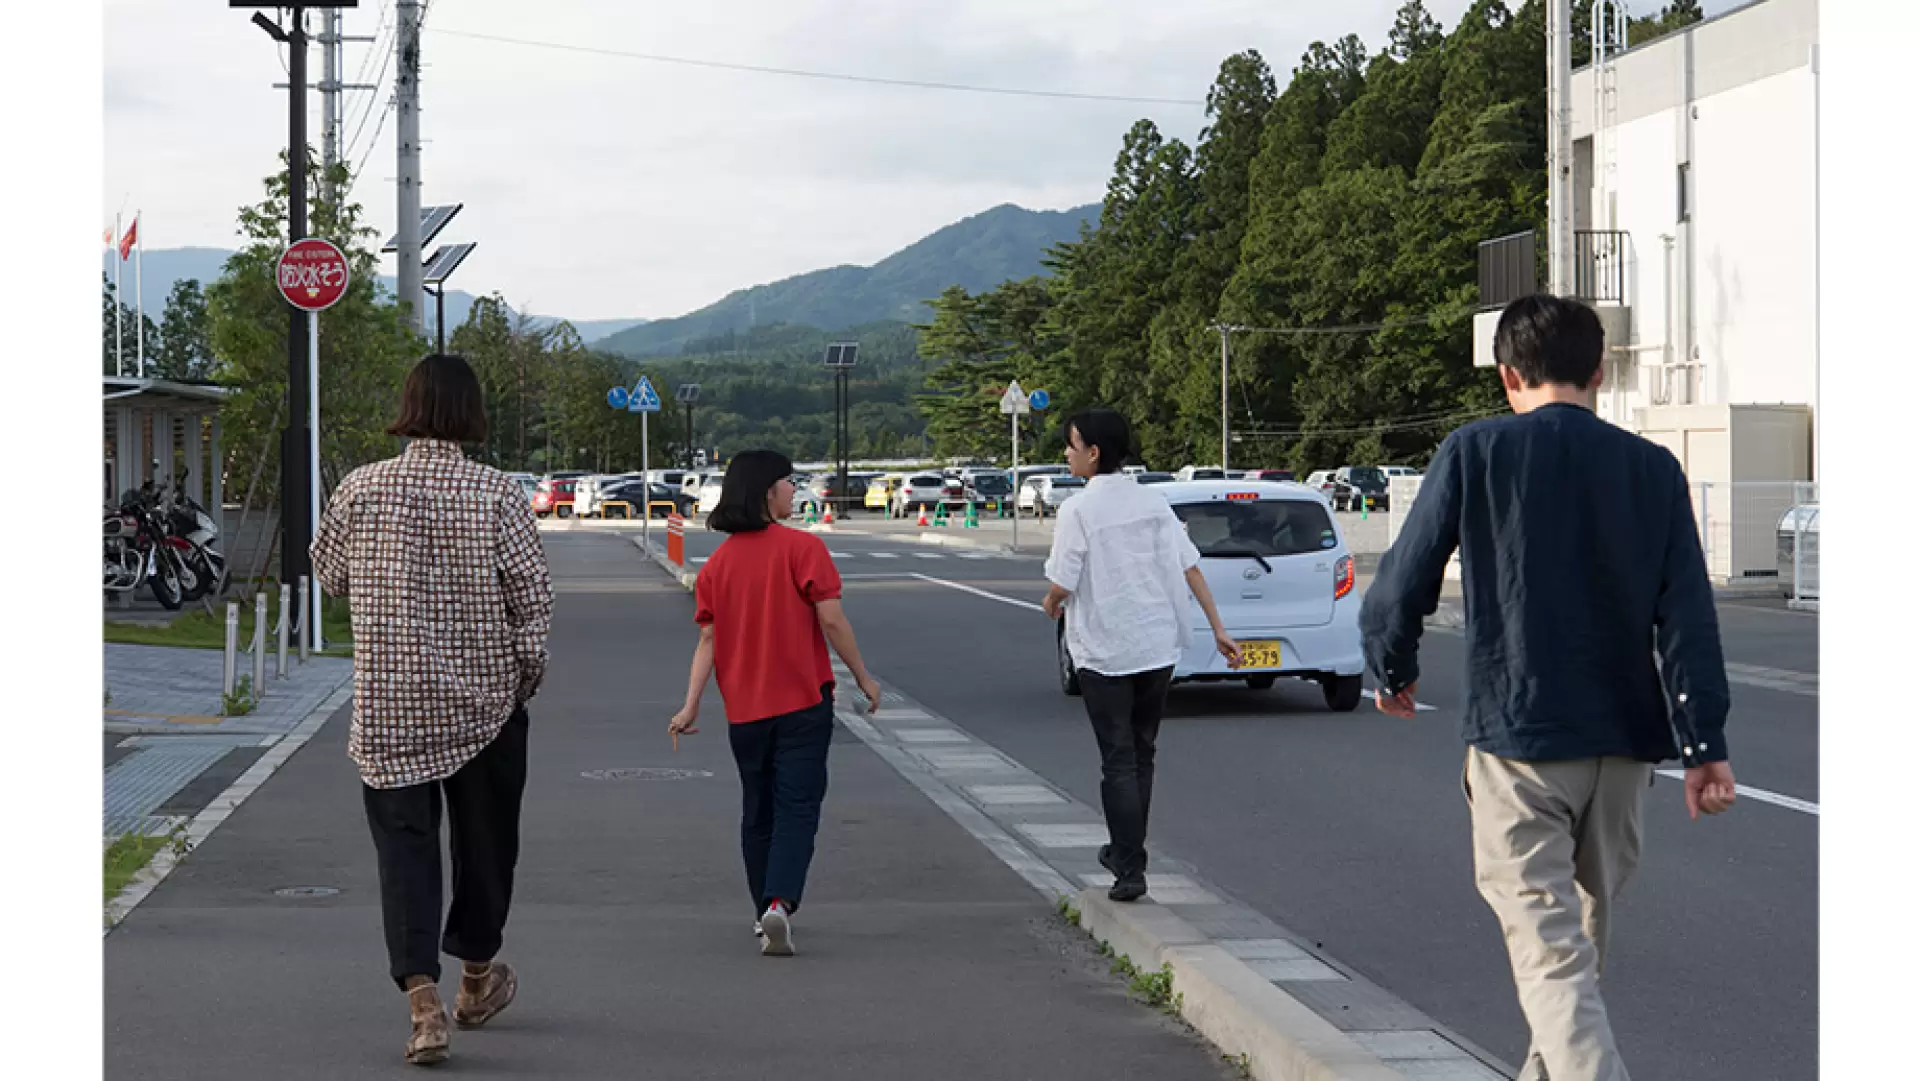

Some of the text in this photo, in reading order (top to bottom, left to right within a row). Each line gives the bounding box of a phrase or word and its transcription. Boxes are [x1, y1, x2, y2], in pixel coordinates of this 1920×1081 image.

[281, 262, 344, 288] 防火水そう
